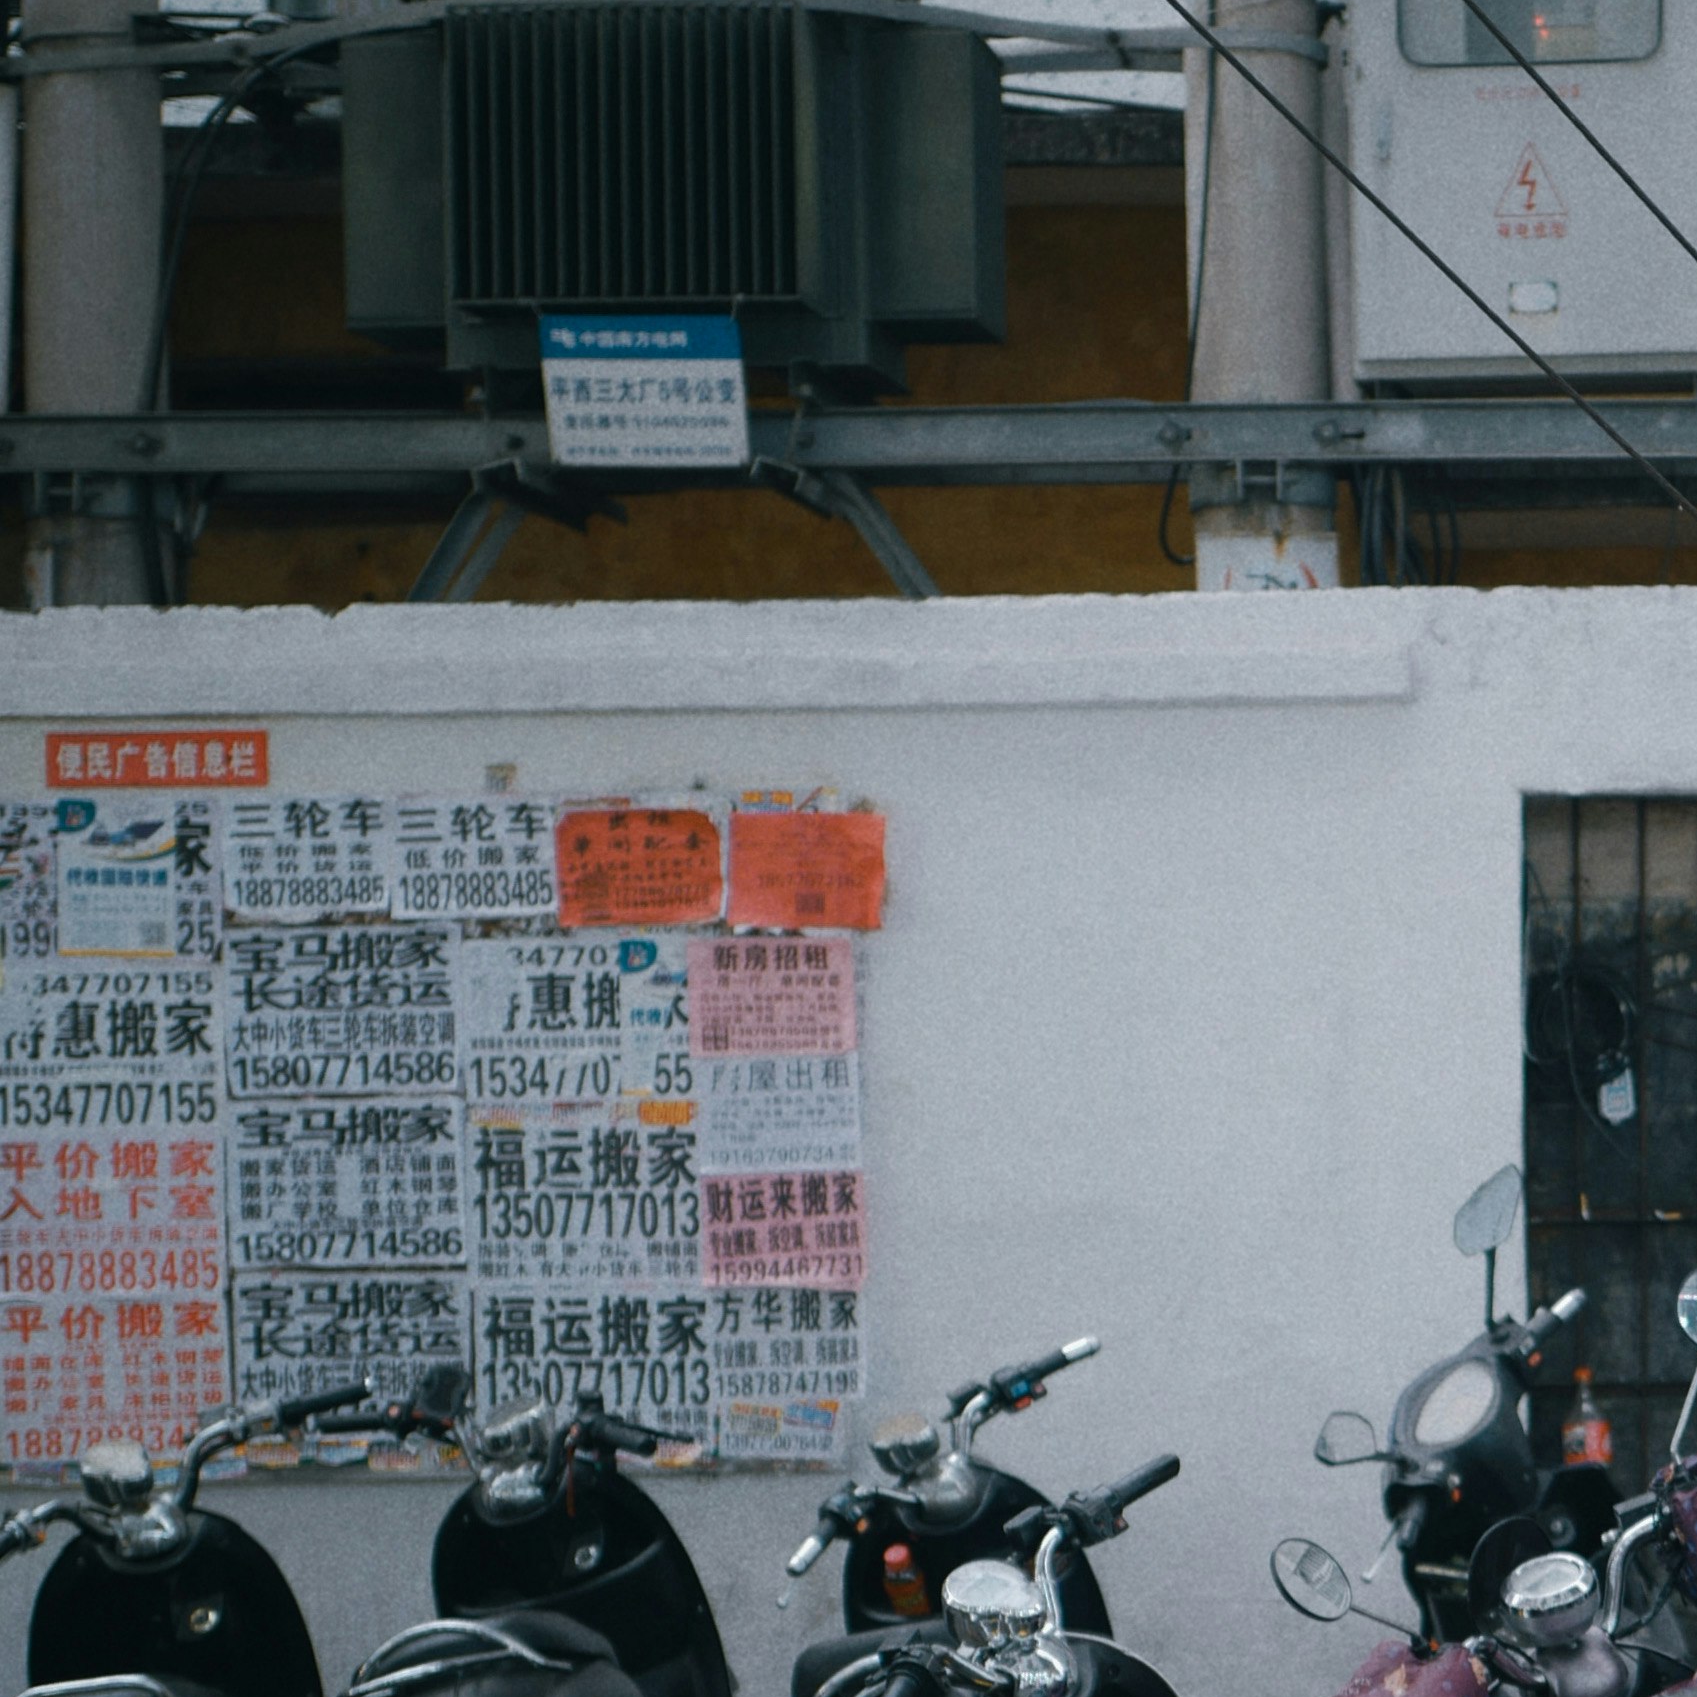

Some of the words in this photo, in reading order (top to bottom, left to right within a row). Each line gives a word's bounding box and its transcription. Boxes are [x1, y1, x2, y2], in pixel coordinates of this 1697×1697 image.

[57, 741, 256, 780] 便民广告信息栏
[230, 800, 386, 839] 三轮车
[396, 803, 549, 843] 三轮车
[405, 846, 540, 869] 低价搬家
[234, 875, 386, 907] 18878883485
[401, 870, 553, 911] 18878883485
[0, 921, 59, 957] 99
[178, 921, 215, 956] 25
[229, 930, 449, 975] 宝马搬家
[713, 945, 829, 973] 新房招租
[231, 973, 450, 1014] 长途货运
[232, 1012, 456, 1053] 大中小货车三轮车拆装空调
[232, 1052, 456, 1092] 15807714586
[653, 1052, 694, 1094] 55
[0, 1082, 218, 1128] 15347707155
[237, 1105, 456, 1148] 宝马搬家
[0, 1139, 217, 1182] 平价搬家
[474, 1127, 698, 1193] 福运搬家
[0, 1184, 217, 1221] 入地下室
[473, 1191, 700, 1240] 13507717013
[707, 1171, 859, 1224] 财运来搬家
[236, 1227, 464, 1264] 15807714586
[0, 1249, 220, 1293] 18878883485
[710, 1252, 864, 1285] 15994467731
[239, 1279, 460, 1322] 宝马搬家
[713, 1289, 859, 1335] 方华搬家
[2, 1301, 220, 1344] 平价搬家
[241, 1318, 462, 1361] 长途货运
[482, 1294, 707, 1358] 福运搬家
[715, 1369, 859, 1399] 15878747198
